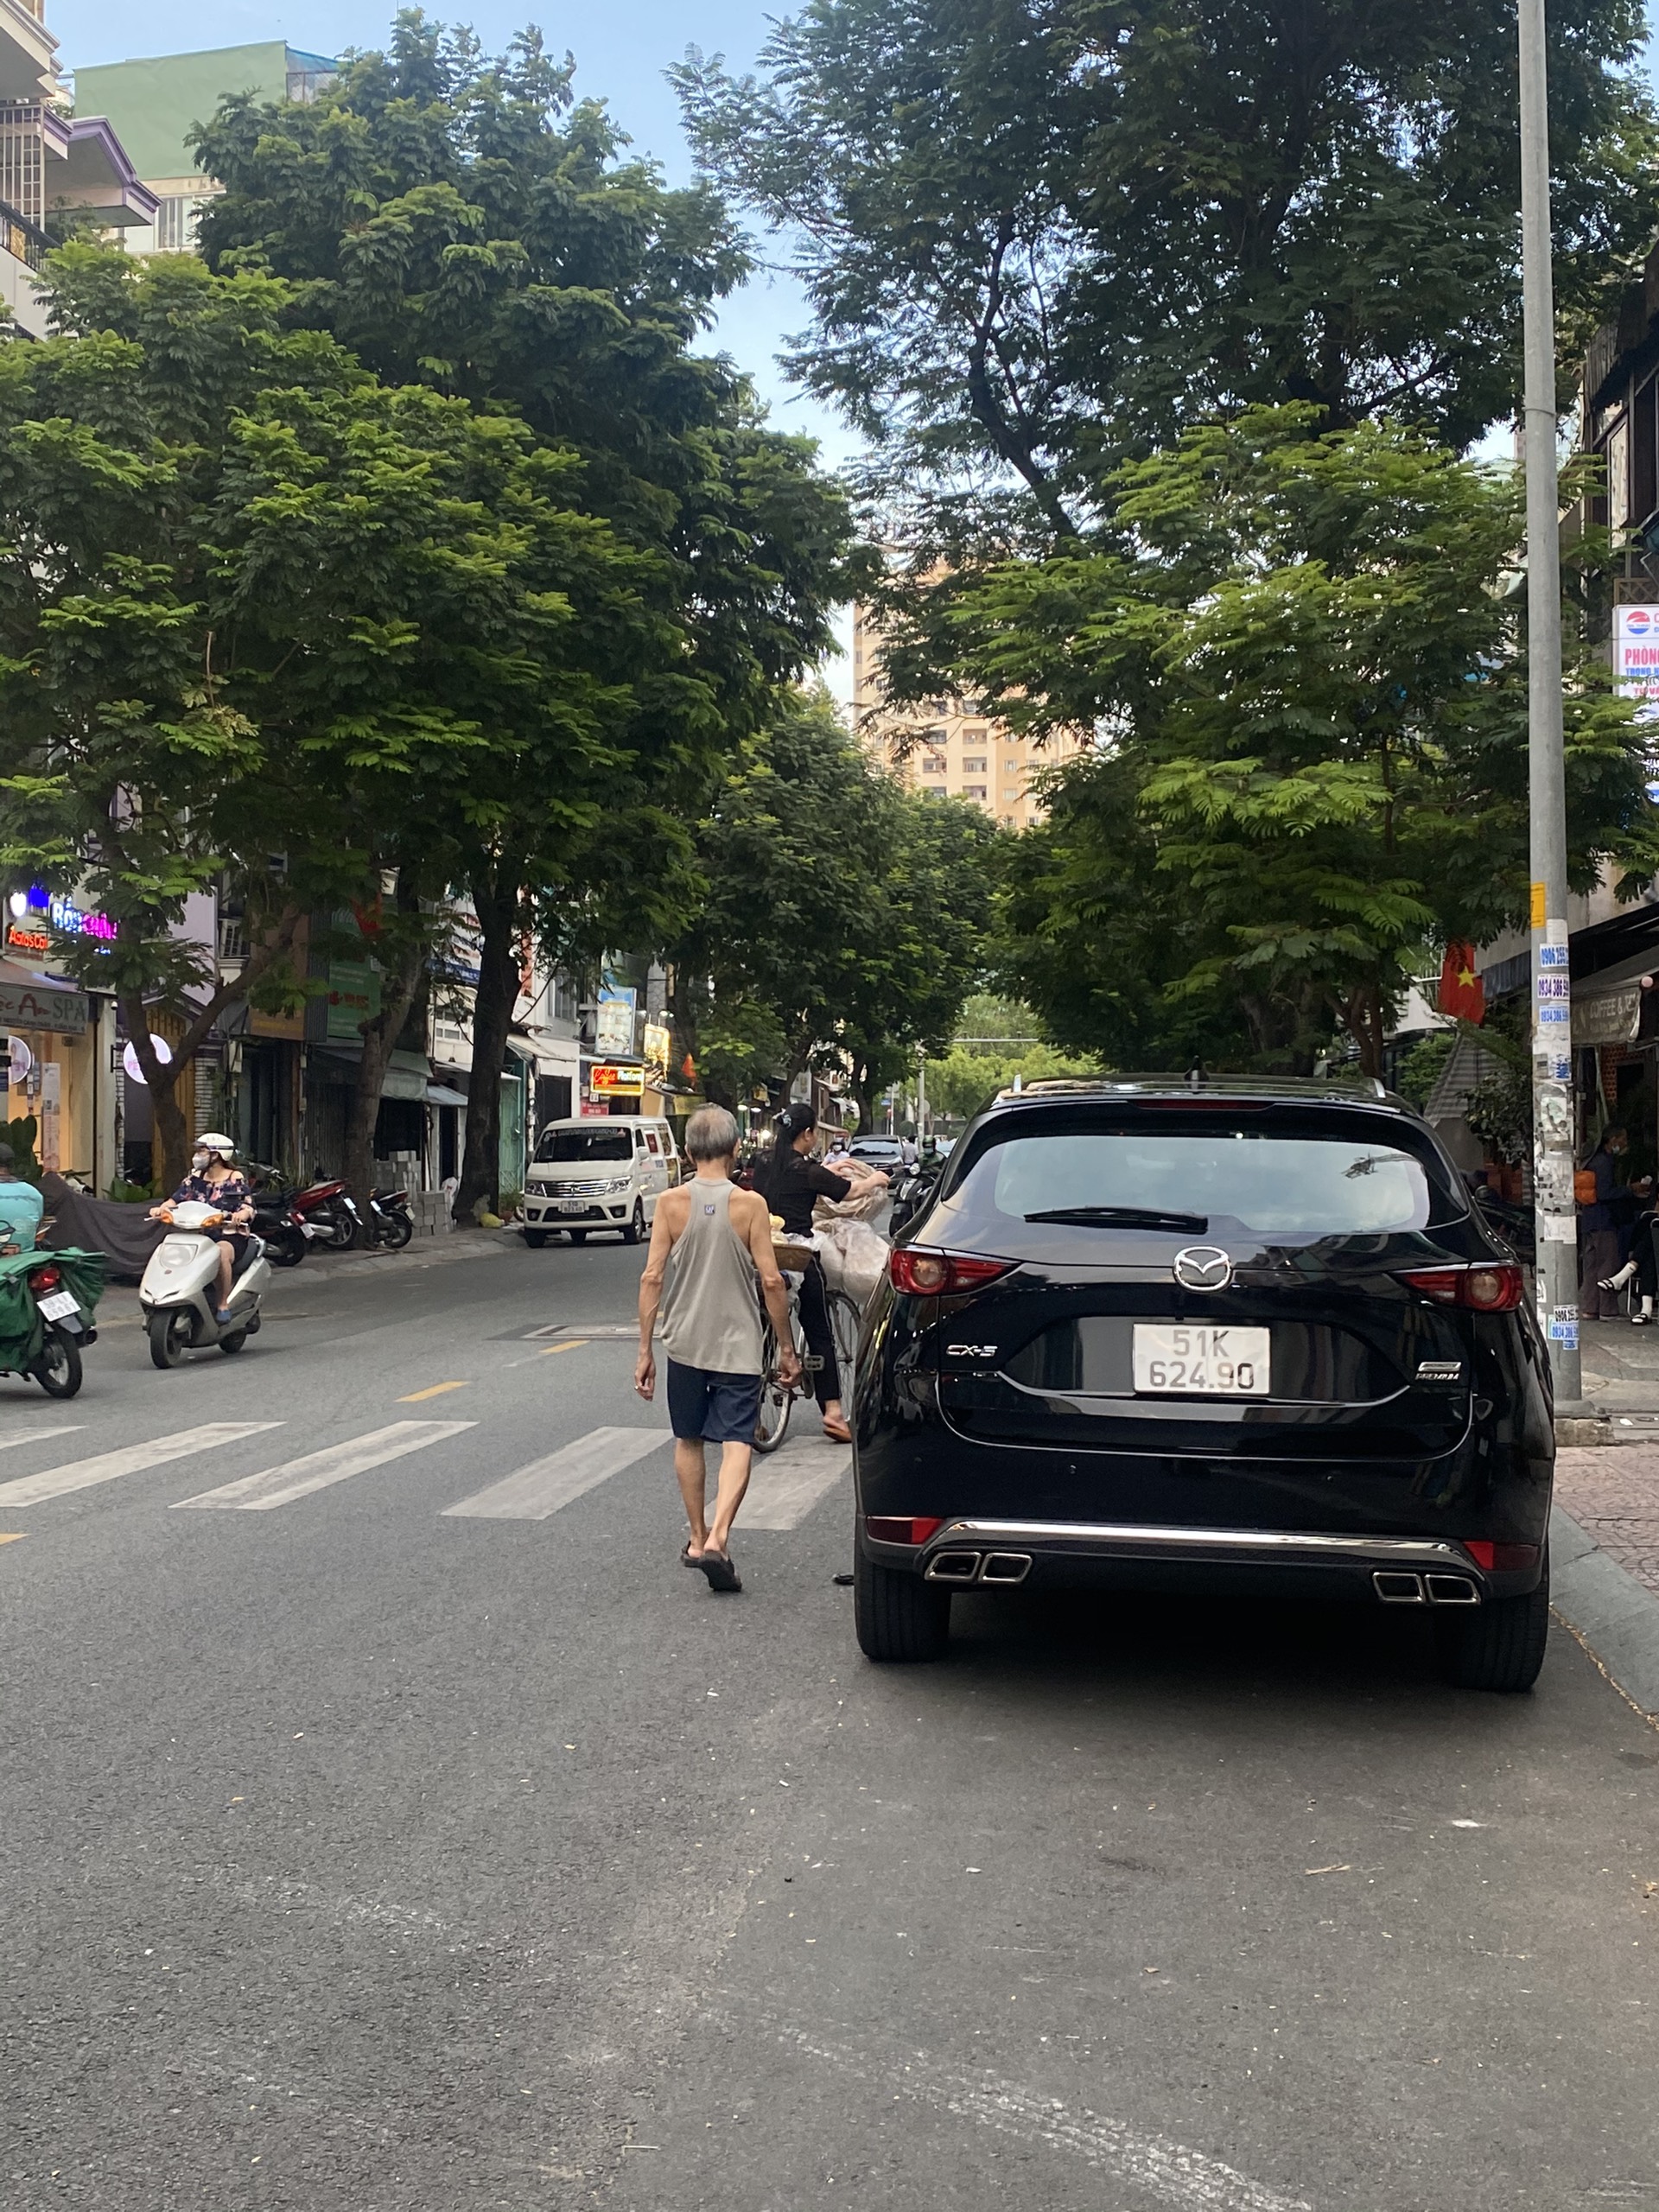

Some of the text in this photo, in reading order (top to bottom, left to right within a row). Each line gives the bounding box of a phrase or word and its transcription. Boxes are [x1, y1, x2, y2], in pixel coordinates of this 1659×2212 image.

[1625, 646, 1659, 665] PHÒN
[53, 996, 86, 1021] SPA
[946, 1344, 998, 1357] CX-5
[1173, 1330, 1230, 1357] 51K
[1149, 1361, 1255, 1389] 624.90
